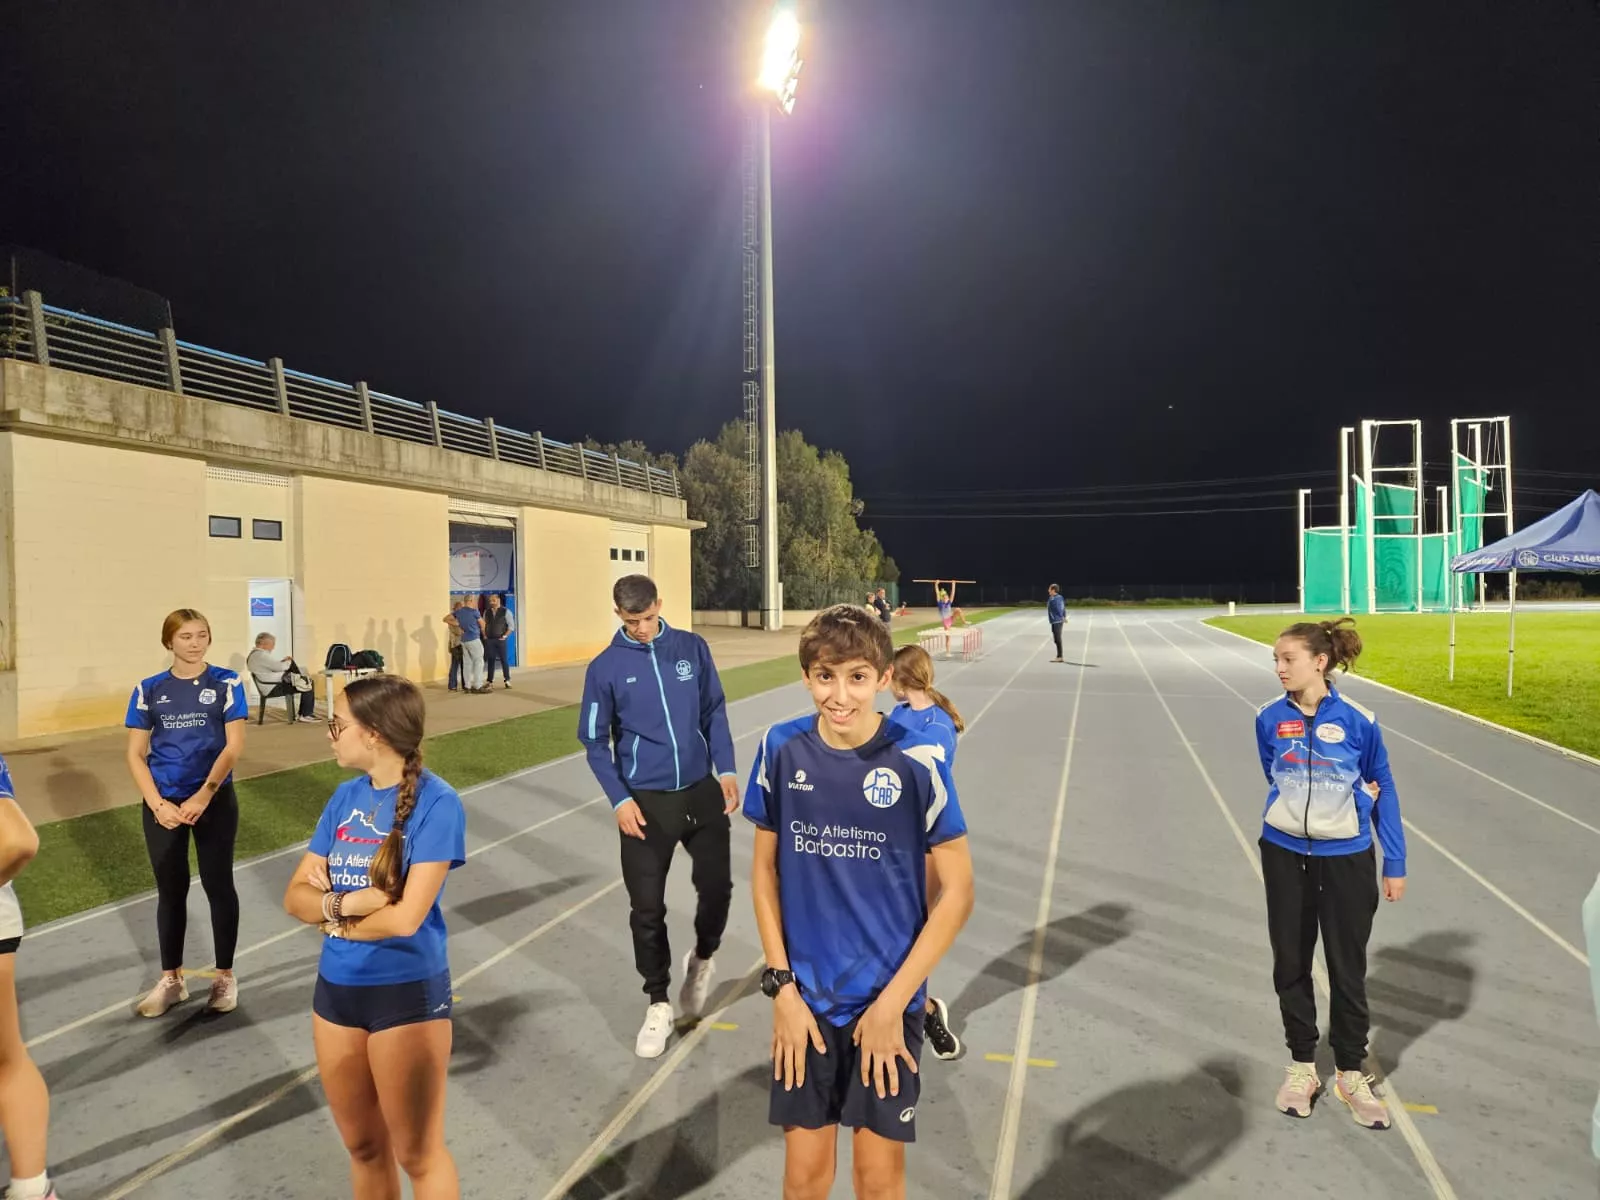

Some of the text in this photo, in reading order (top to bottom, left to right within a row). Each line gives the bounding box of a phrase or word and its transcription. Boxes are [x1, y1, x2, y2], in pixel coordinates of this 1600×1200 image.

[1543, 553, 1570, 562] Club
[788, 781, 814, 792] VIATOR
[871, 786, 893, 805] CAB
[790, 819, 887, 842] Club Atletismo
[794, 834, 881, 860] Barbastro
